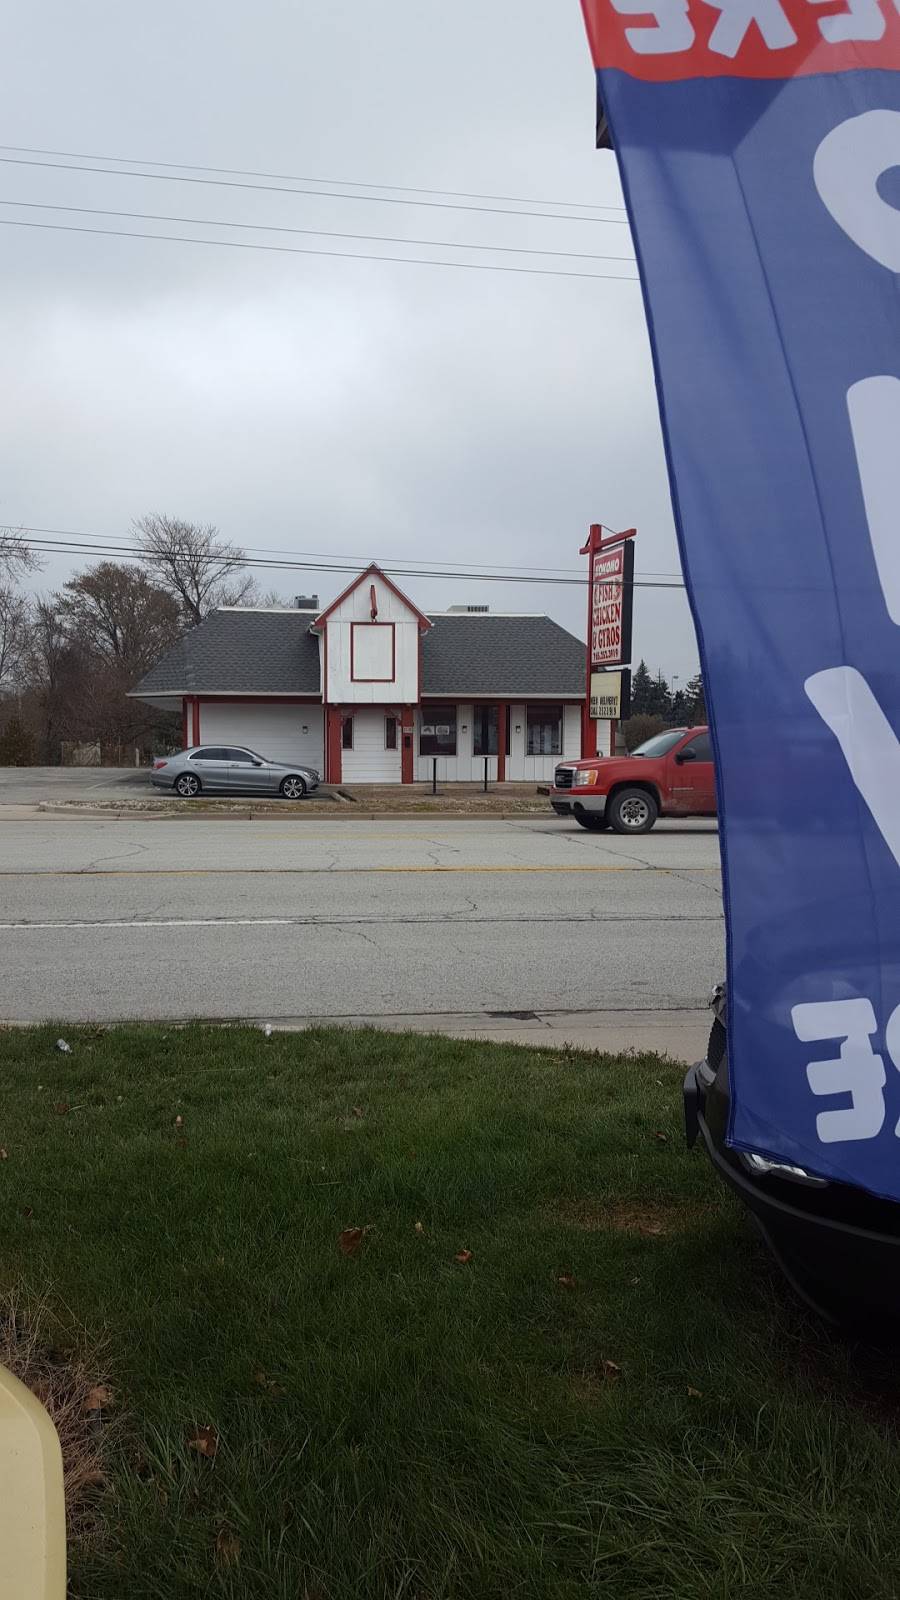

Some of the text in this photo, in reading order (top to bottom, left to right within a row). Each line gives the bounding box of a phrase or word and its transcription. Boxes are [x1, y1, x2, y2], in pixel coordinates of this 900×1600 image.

[598, 581, 613, 603] FISH
[593, 602, 621, 627] CHICKEN
[598, 626, 620, 649] GYROS
